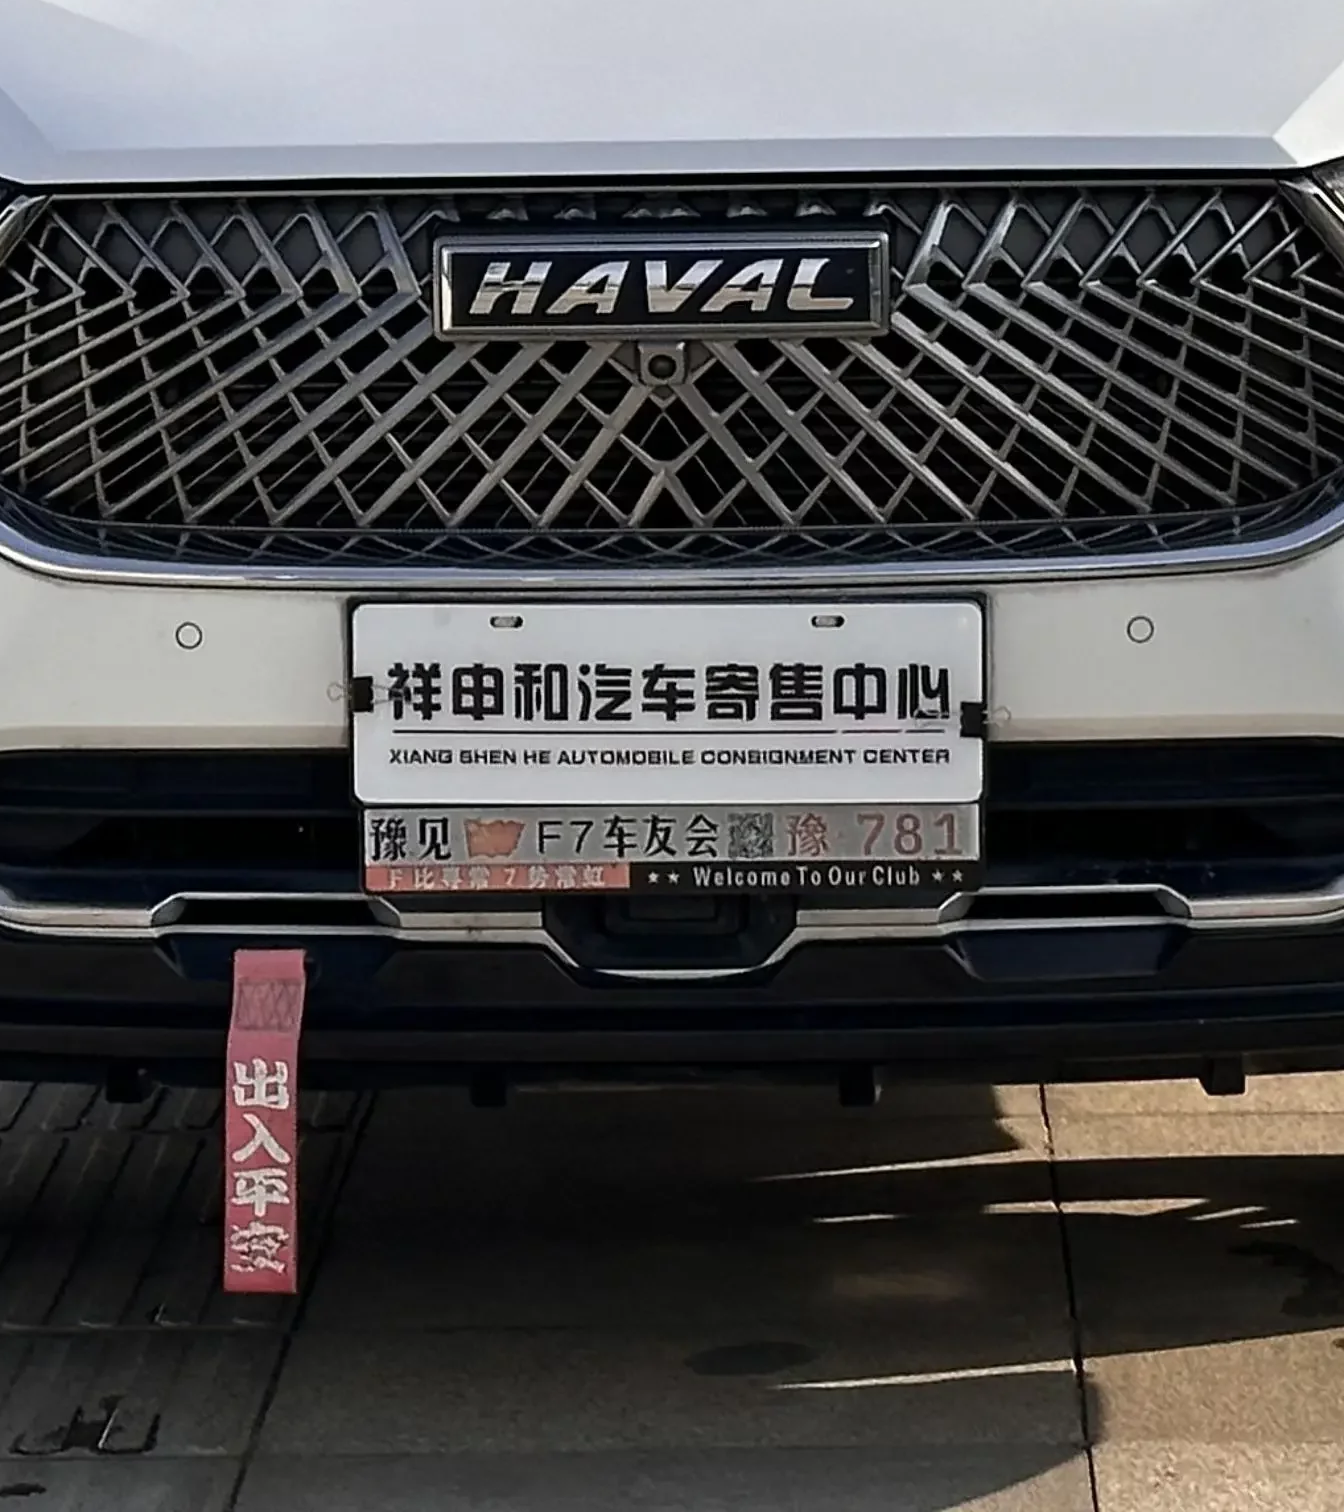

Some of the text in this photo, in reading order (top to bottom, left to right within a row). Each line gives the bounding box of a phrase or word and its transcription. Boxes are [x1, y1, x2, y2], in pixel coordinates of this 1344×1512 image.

[468, 258, 854, 315] HAVAL
[389, 749, 453, 765] XIANG
[523, 749, 552, 765] HE
[557, 749, 695, 765] AUTOMOBILE
[701, 749, 856, 765] CONSIGNMENT
[863, 749, 950, 765] CENTER
[857, 813, 963, 856] 781
[693, 866, 920, 887] Welcome To Our Club
